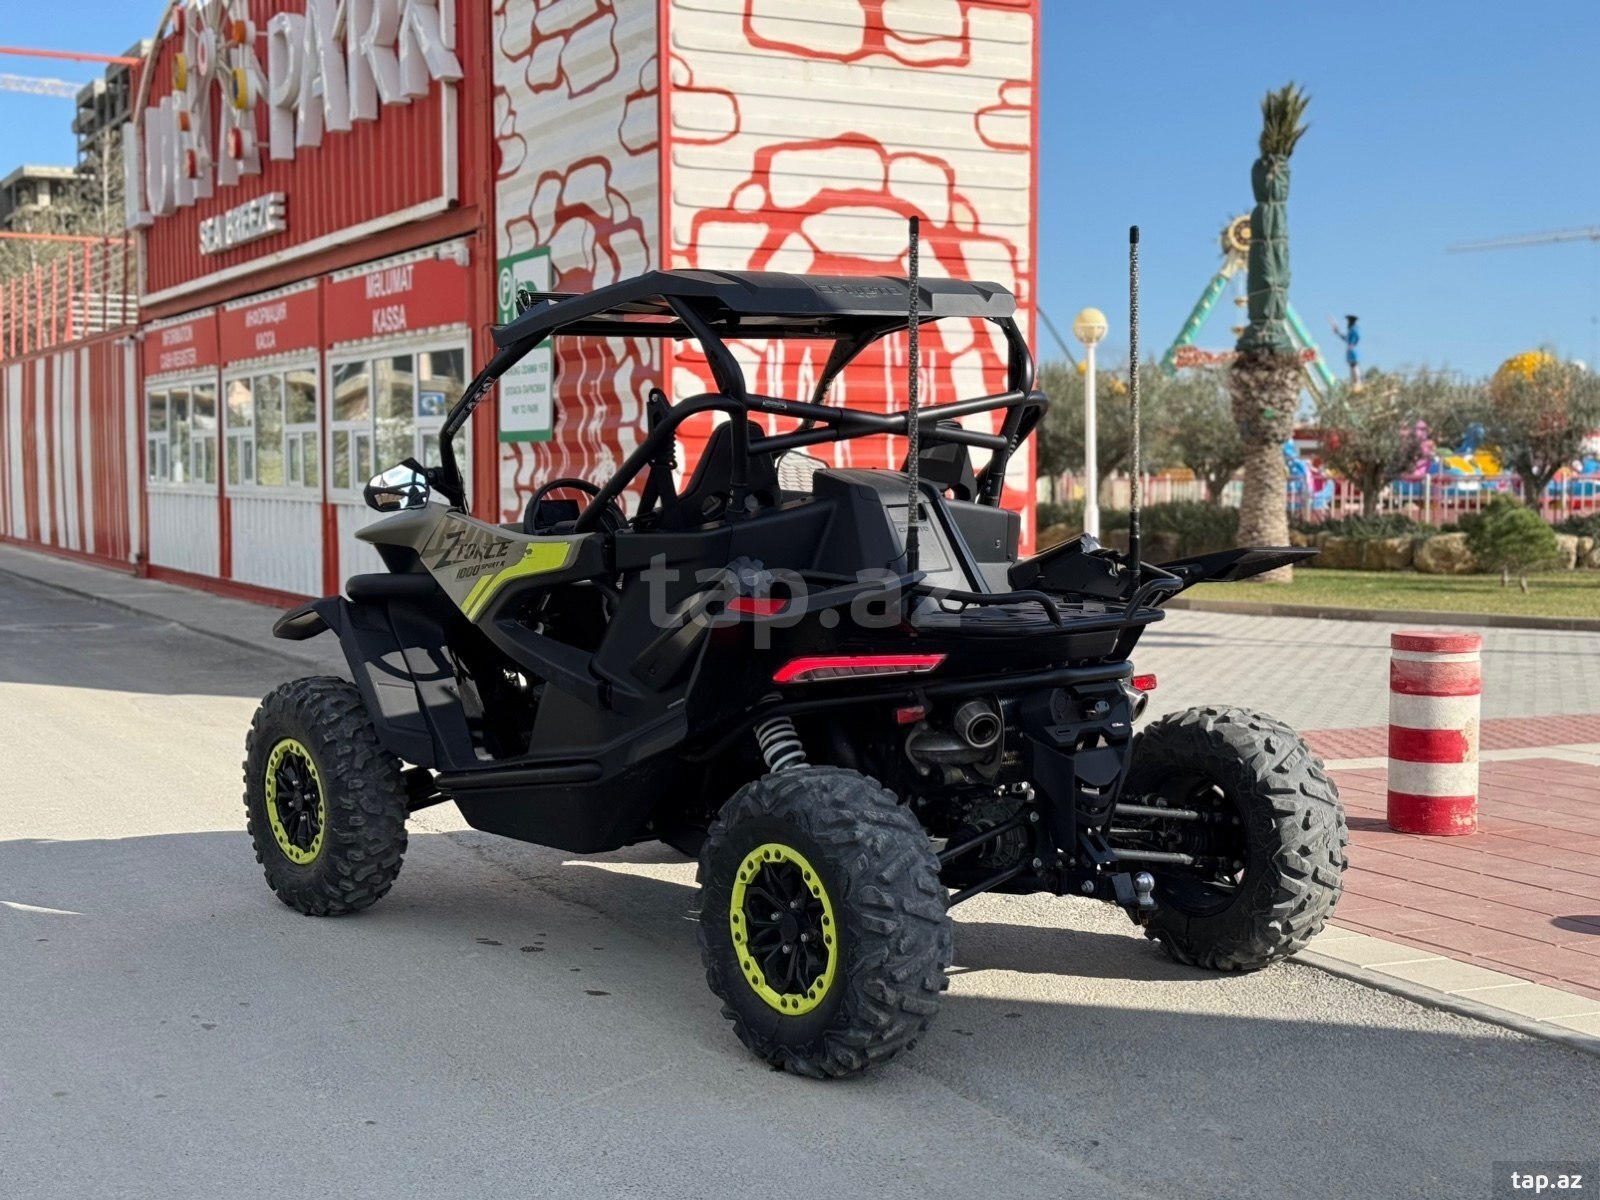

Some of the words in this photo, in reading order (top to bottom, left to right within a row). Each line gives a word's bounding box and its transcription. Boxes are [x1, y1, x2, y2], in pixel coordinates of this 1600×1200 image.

[225, 191, 286, 245] BREEZE
[372, 303, 407, 334] KASSA
[456, 564, 481, 580] 1000
[481, 562, 500, 570] SPORT
